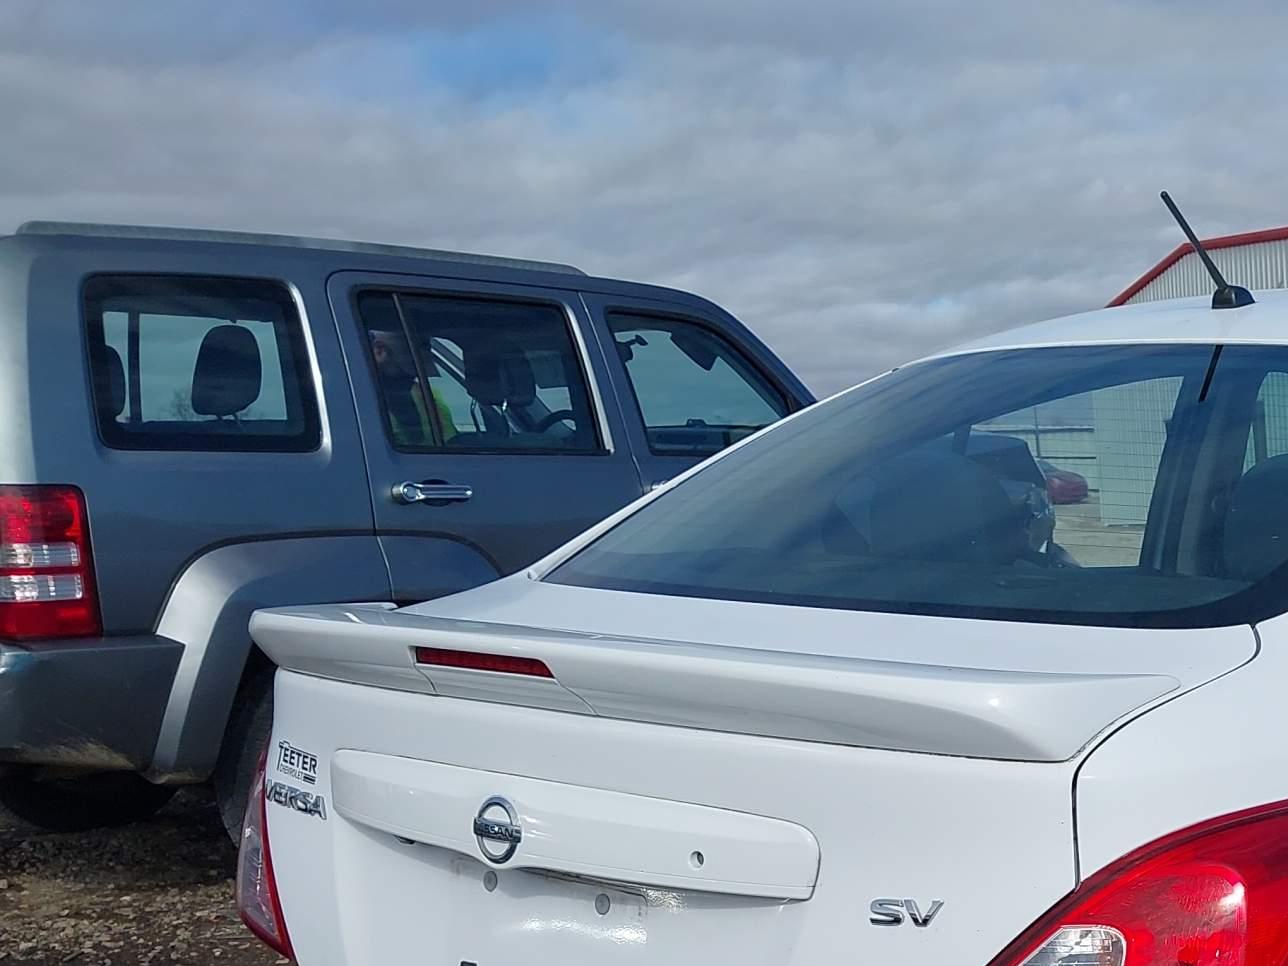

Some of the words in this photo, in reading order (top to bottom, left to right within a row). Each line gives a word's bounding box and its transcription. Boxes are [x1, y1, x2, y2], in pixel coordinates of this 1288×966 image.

[277, 745, 317, 774] TEETER
[266, 779, 327, 820] VERSA
[869, 898, 944, 928] SV
